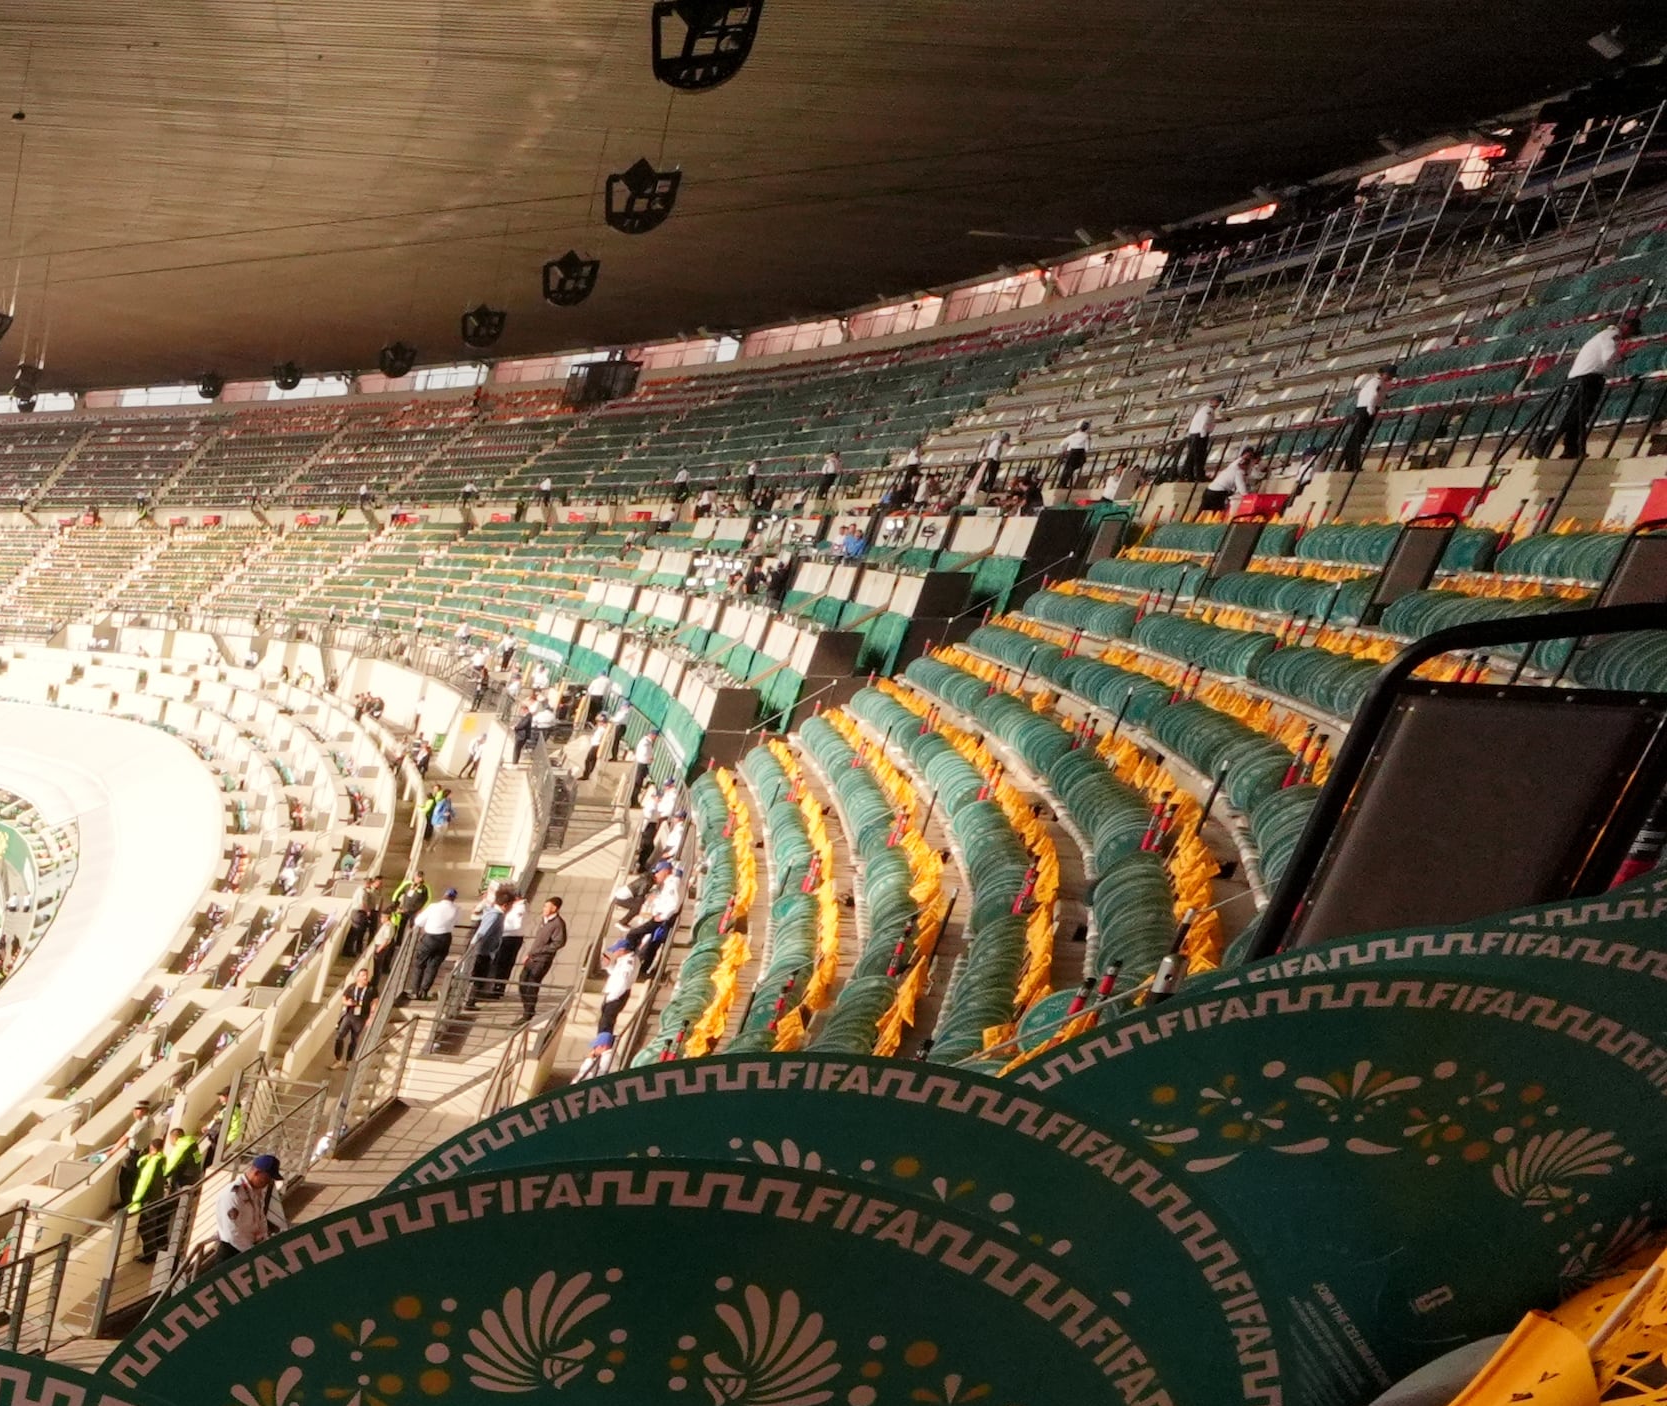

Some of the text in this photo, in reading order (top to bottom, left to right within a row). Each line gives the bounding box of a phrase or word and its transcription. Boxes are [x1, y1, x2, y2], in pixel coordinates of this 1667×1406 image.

[1248, 953, 1332, 983] FIFA
[1479, 931, 1564, 960] FIFA
[1157, 997, 1250, 1035] FIFA
[1430, 983, 1535, 1017] FIFA
[779, 1061, 873, 1095] FIFA
[529, 1085, 619, 1134] FIFA
[1035, 1113, 1120, 1182] FIFA
[467, 1174, 585, 1220] FIFA
[801, 1186, 923, 1250] FIFA
[201, 1252, 281, 1320] FIFA
[1219, 1271, 1276, 1354] FIFA
